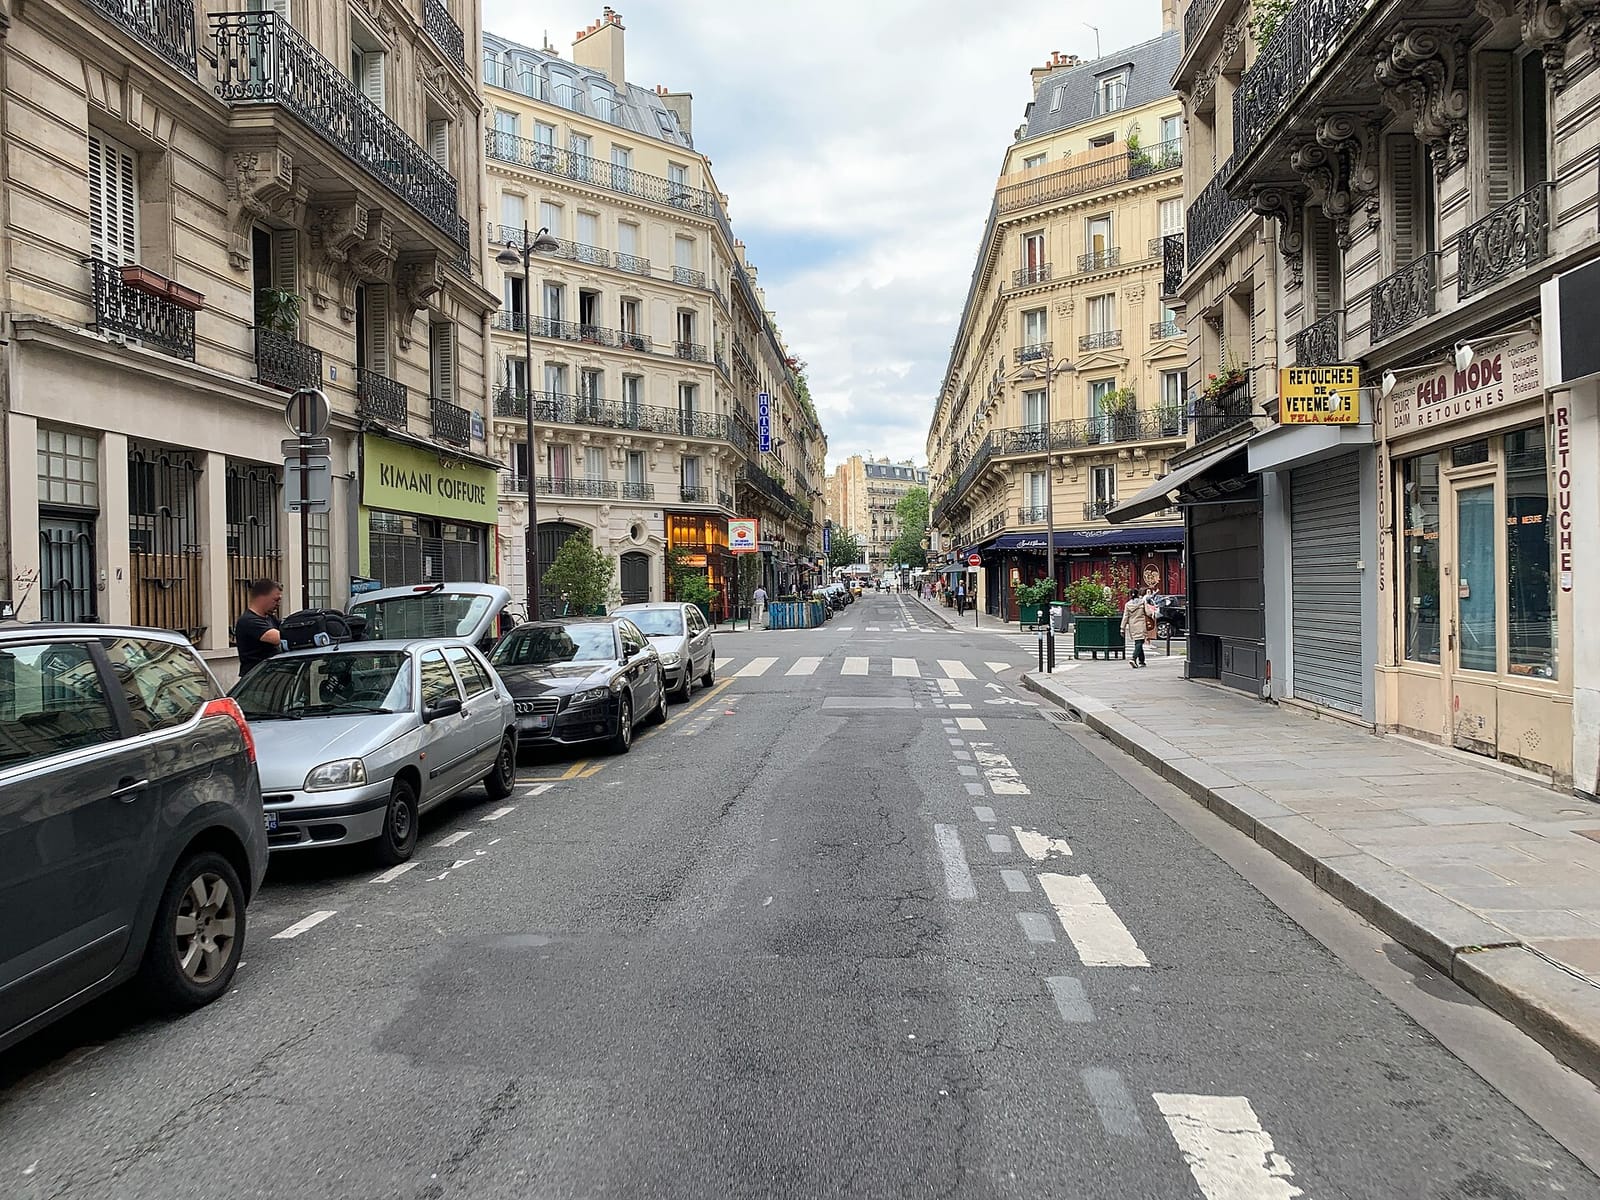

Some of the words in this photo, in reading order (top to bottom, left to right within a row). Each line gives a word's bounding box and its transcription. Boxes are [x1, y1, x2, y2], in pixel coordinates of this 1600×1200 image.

[1507, 340, 1539, 357] CONFECTION
[1289, 368, 1353, 385] RETOUCHES
[1416, 374, 1447, 408] FELA
[1453, 353, 1503, 396] MODE
[1512, 367, 1539, 383] Doubles
[1314, 386, 1327, 395] DE
[1513, 380, 1540, 395] Rideaux
[1286, 396, 1351, 412] VETEMETS
[1393, 398, 1410, 414] CUIR
[1418, 388, 1504, 426] RETOUCHES
[760, 395, 769, 446] HOTEL
[1290, 413, 1319, 423] FELA
[1394, 412, 1411, 429] DAIM
[380, 462, 432, 495] KIMANI
[437, 477, 486, 505] COIFFURE
[1556, 407, 1572, 593] RETOUCHE
